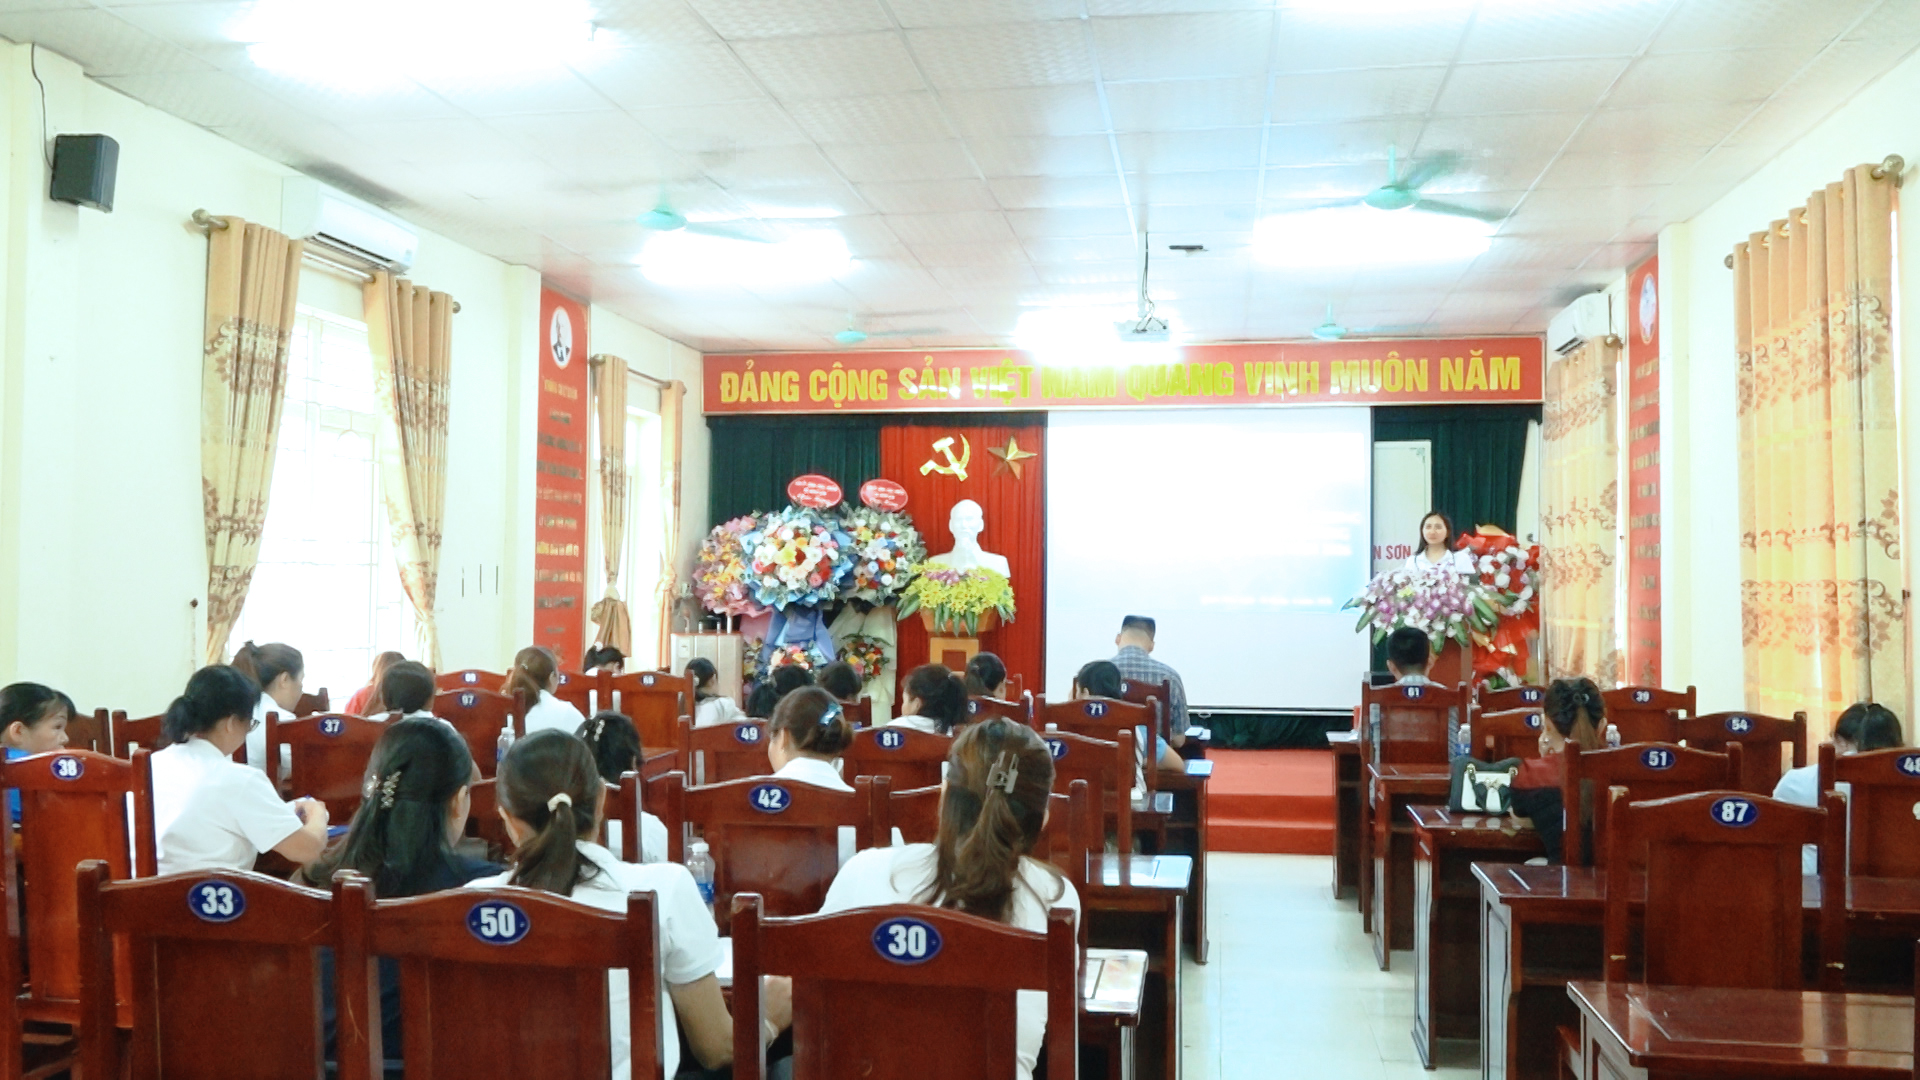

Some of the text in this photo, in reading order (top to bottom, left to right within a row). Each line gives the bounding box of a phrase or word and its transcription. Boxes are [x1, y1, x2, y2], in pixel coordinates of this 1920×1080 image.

[720, 349, 1521, 408] ĐẢNG CỘNG SẢN VIỆT NAM QUANG VINH MUÔN NĂM
[1386, 543, 1411, 560] SƠN
[1088, 702, 1103, 716] 71
[324, 719, 340, 733] 37
[1731, 717, 1748, 731] 54
[740, 726, 758, 741] 49
[882, 731, 898, 746] 81
[1648, 751, 1667, 767] 51
[58, 759, 77, 777] 38
[758, 788, 783, 808] 42
[1721, 801, 1749, 823] 87
[201, 886, 233, 915] 33
[480, 907, 515, 938] 50
[888, 924, 927, 957] 30
